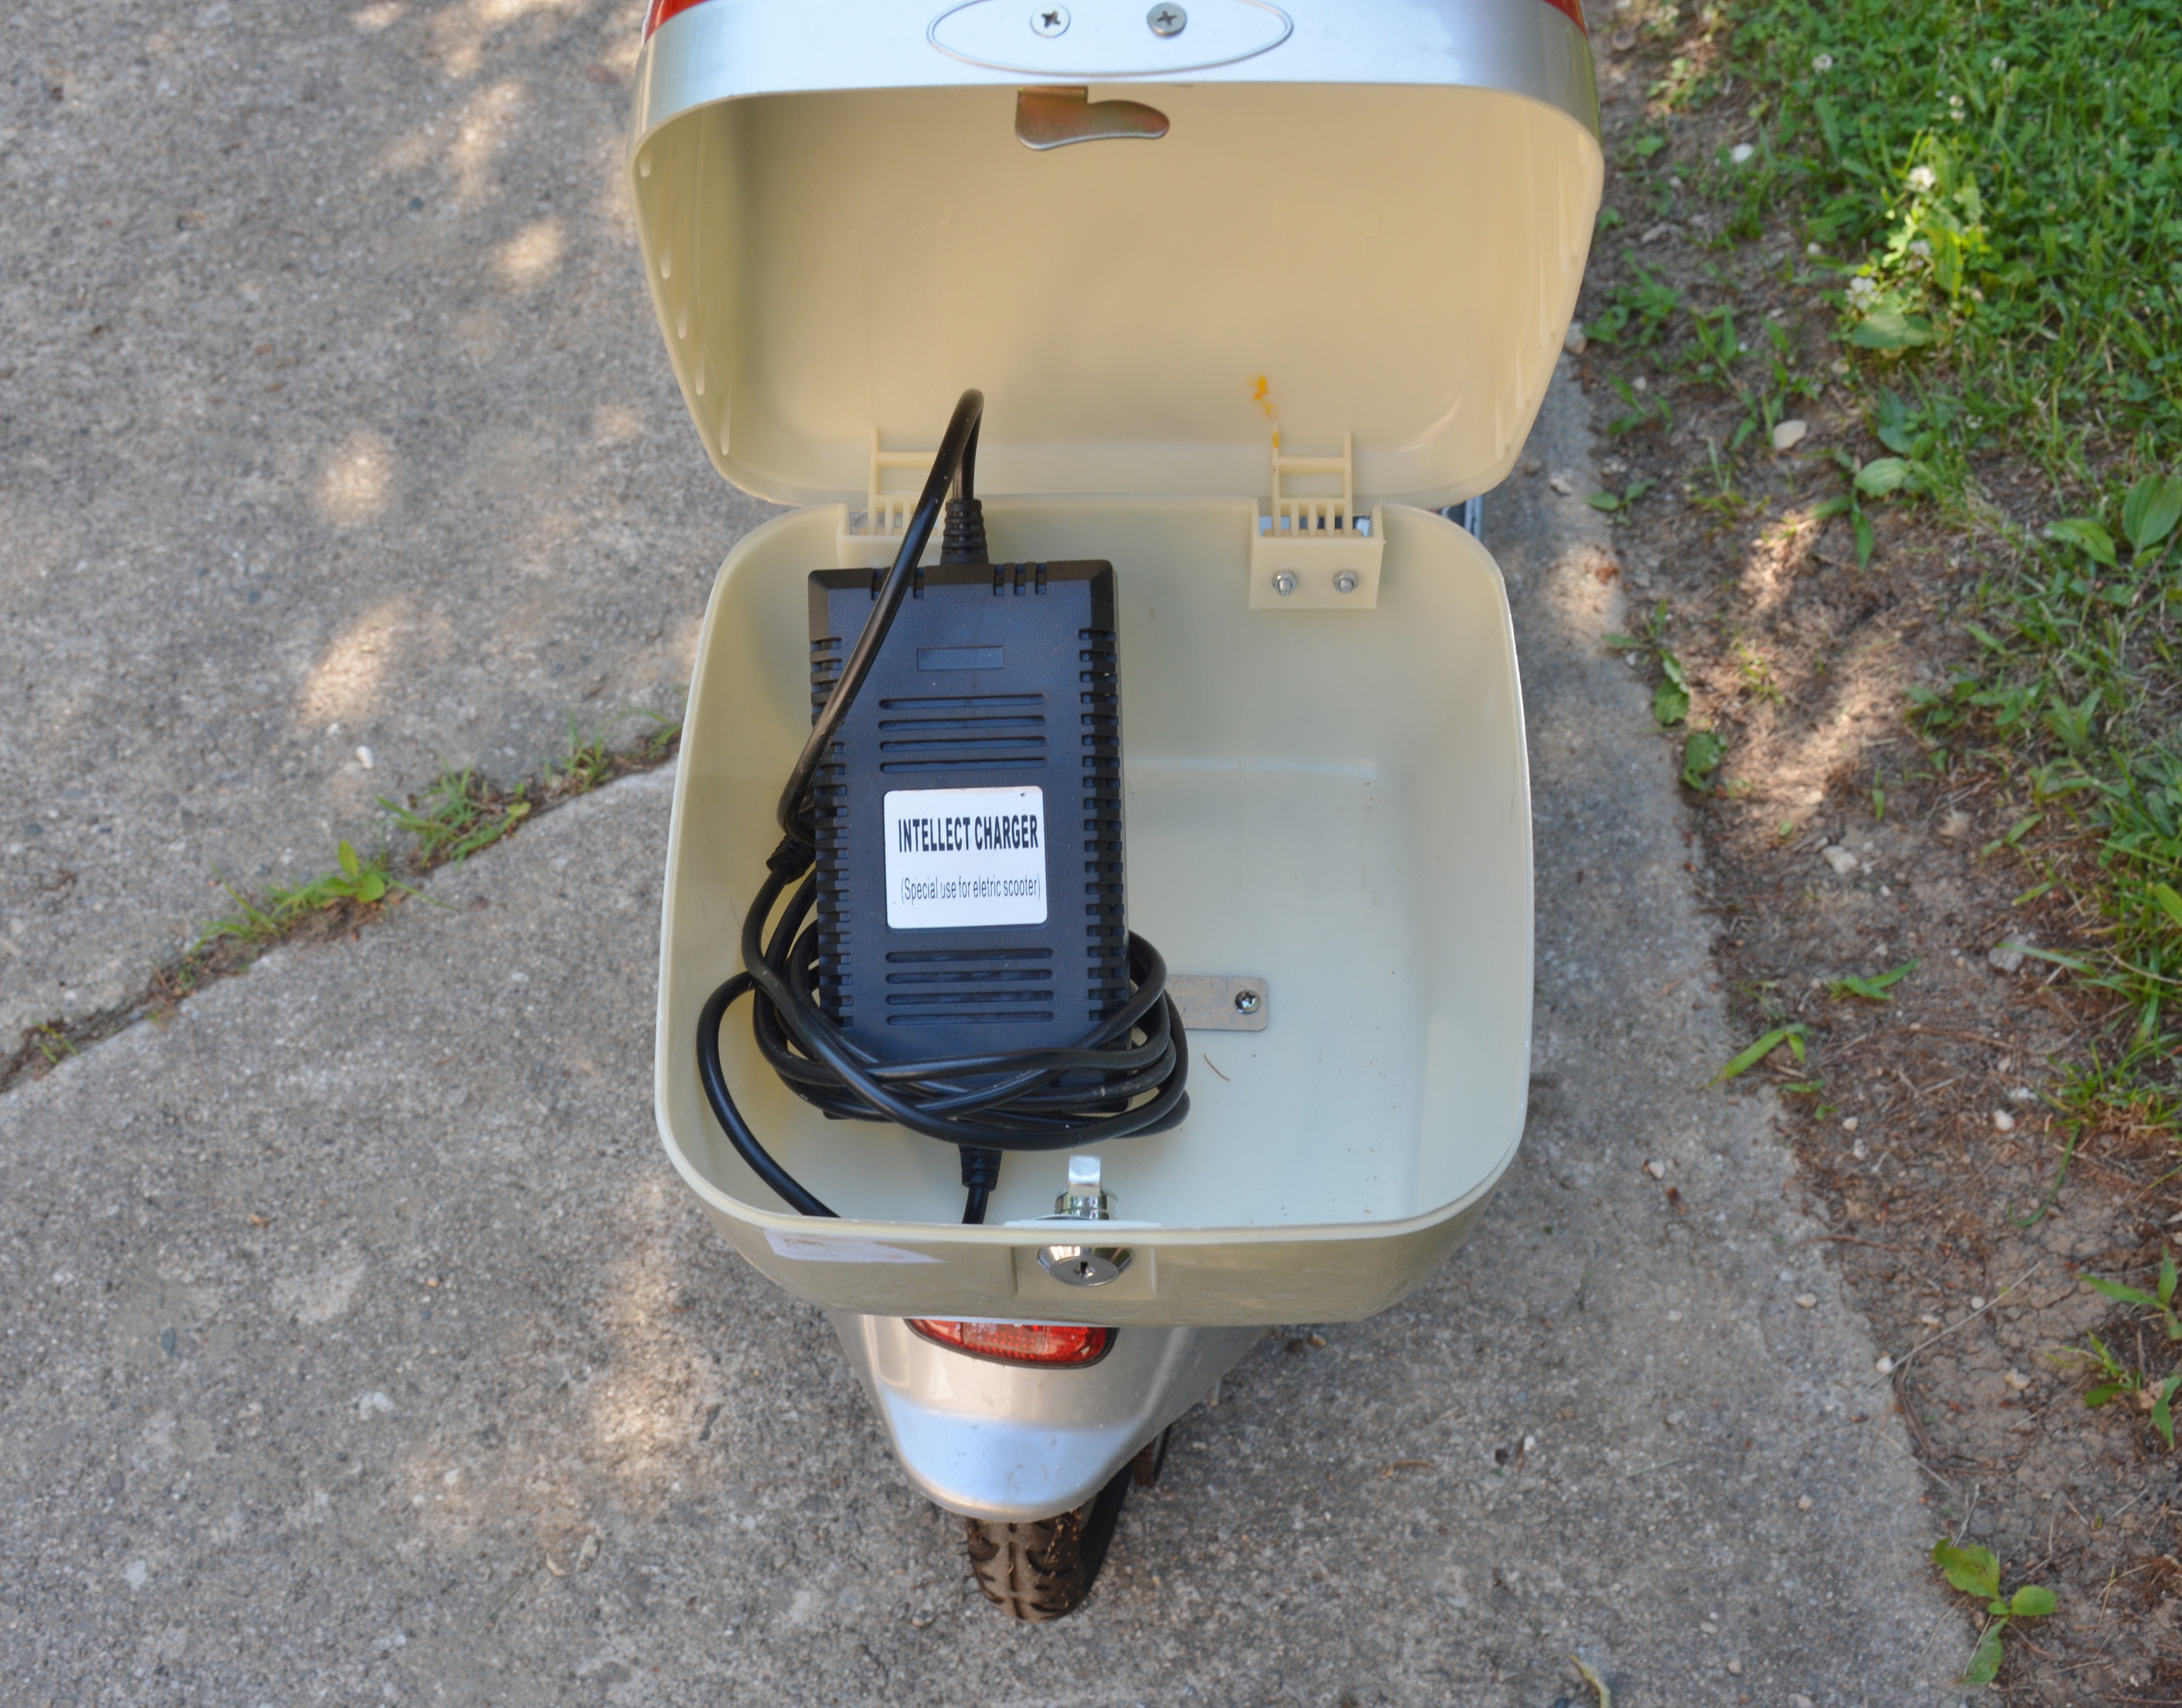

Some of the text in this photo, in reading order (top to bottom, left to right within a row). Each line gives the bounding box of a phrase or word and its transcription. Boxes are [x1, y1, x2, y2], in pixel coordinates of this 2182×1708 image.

[898, 815, 1038, 853] INTELLECT CHARGER
[902, 874, 1040, 905] (Special use for eletric scooter)
